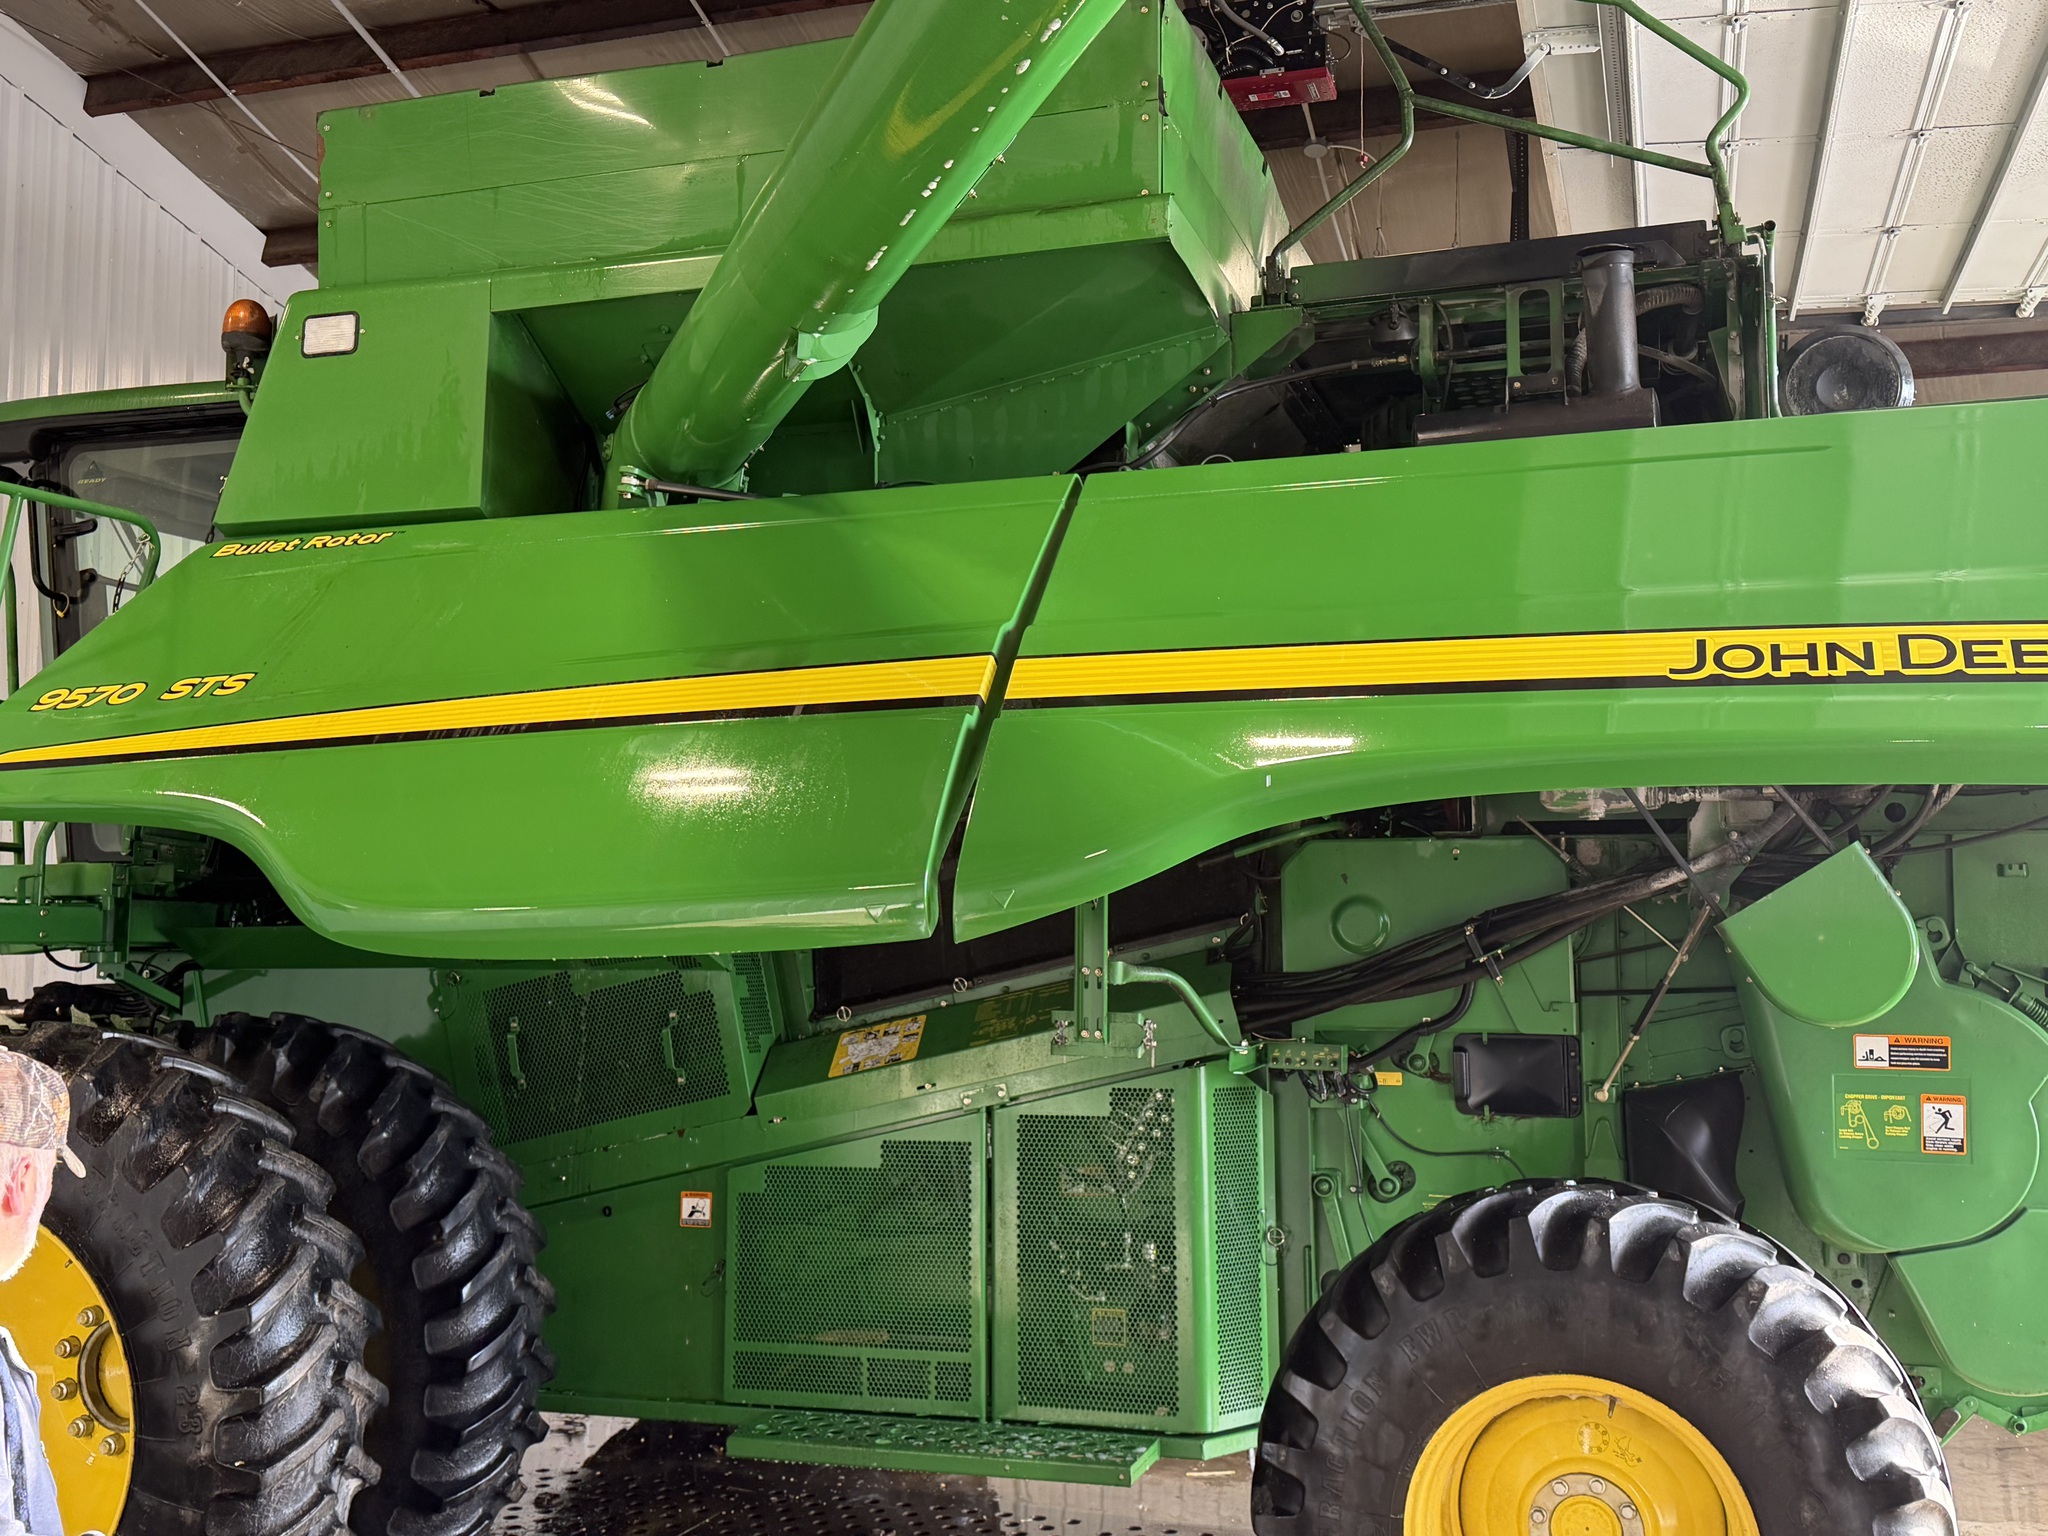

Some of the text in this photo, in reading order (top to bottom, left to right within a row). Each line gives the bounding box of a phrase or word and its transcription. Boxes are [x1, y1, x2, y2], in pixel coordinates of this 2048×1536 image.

[210, 538, 303, 558] Bullet
[1668, 638, 1875, 674] JOHN
[27, 672, 258, 712] 9570 STS
[1904, 1037, 1944, 1045] WARNING
